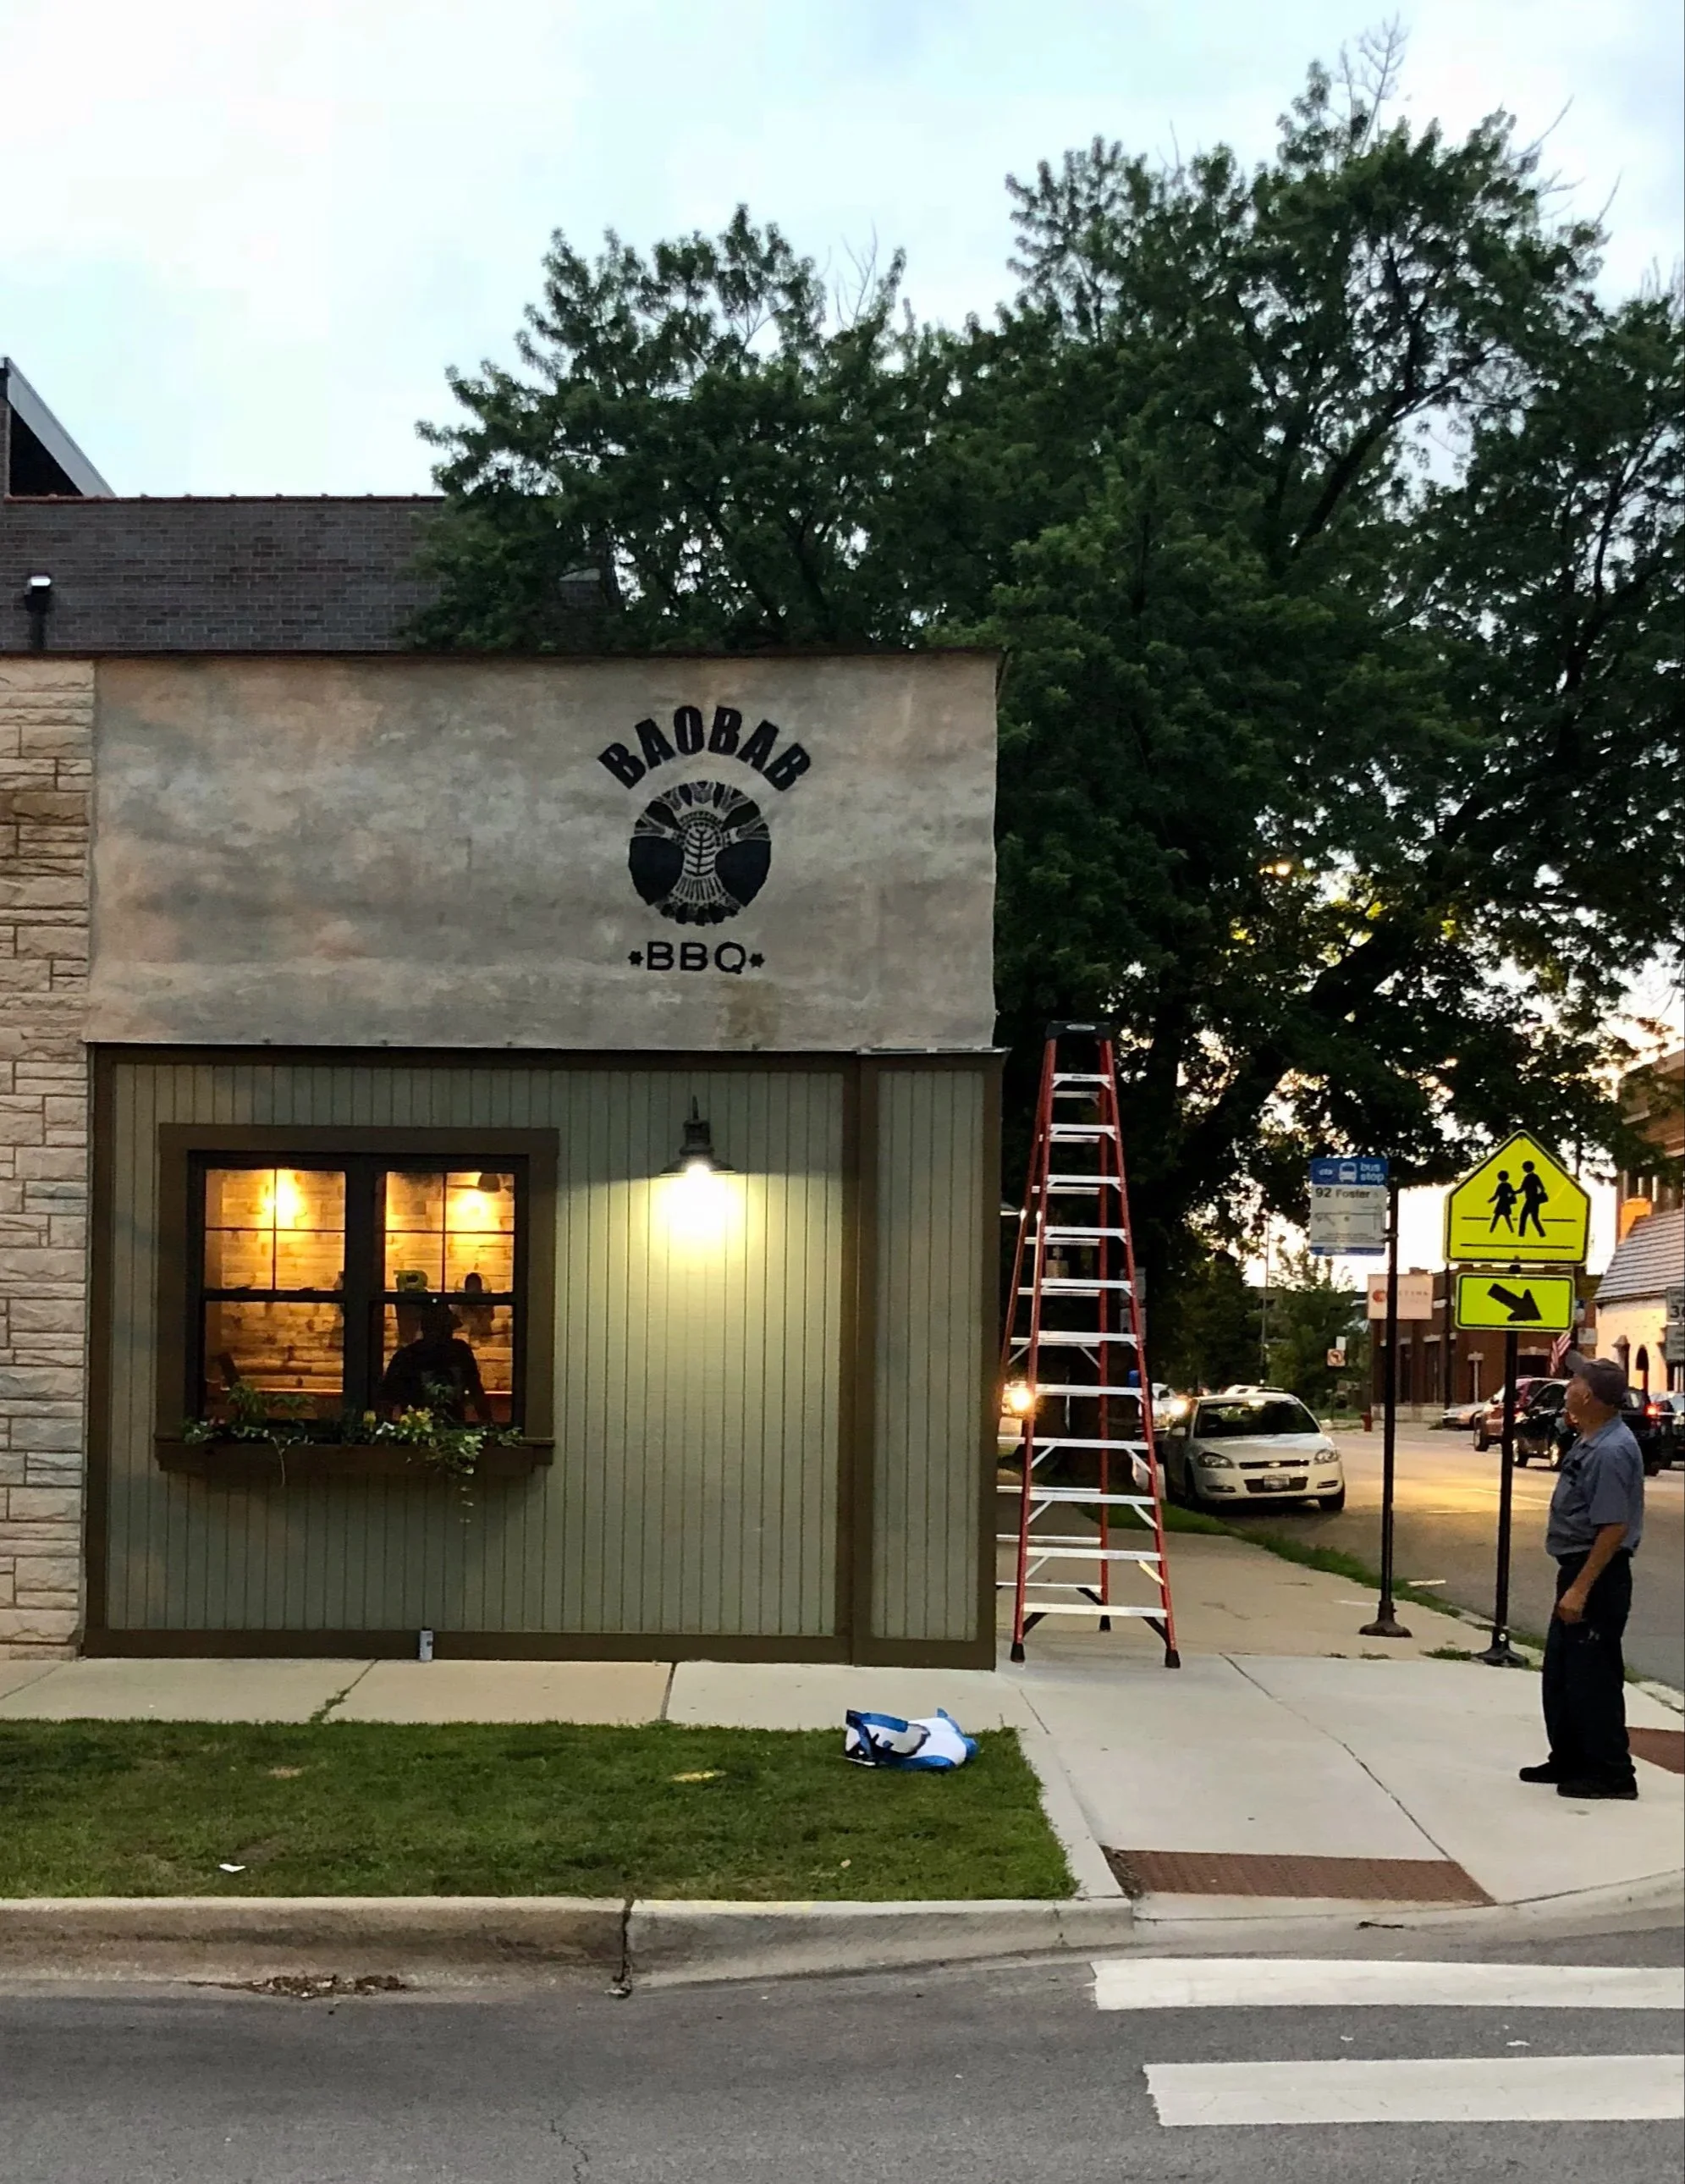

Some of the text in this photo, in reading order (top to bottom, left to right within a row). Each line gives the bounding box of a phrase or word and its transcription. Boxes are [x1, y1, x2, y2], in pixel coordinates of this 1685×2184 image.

[597, 705, 811, 791] BAOBAB
[647, 941, 746, 974] BBQ
[1360, 1162, 1381, 1172] bus
[1360, 1172, 1385, 1183] stop
[1315, 1187, 1332, 1199] 92
[1335, 1189, 1371, 1199] Foster
